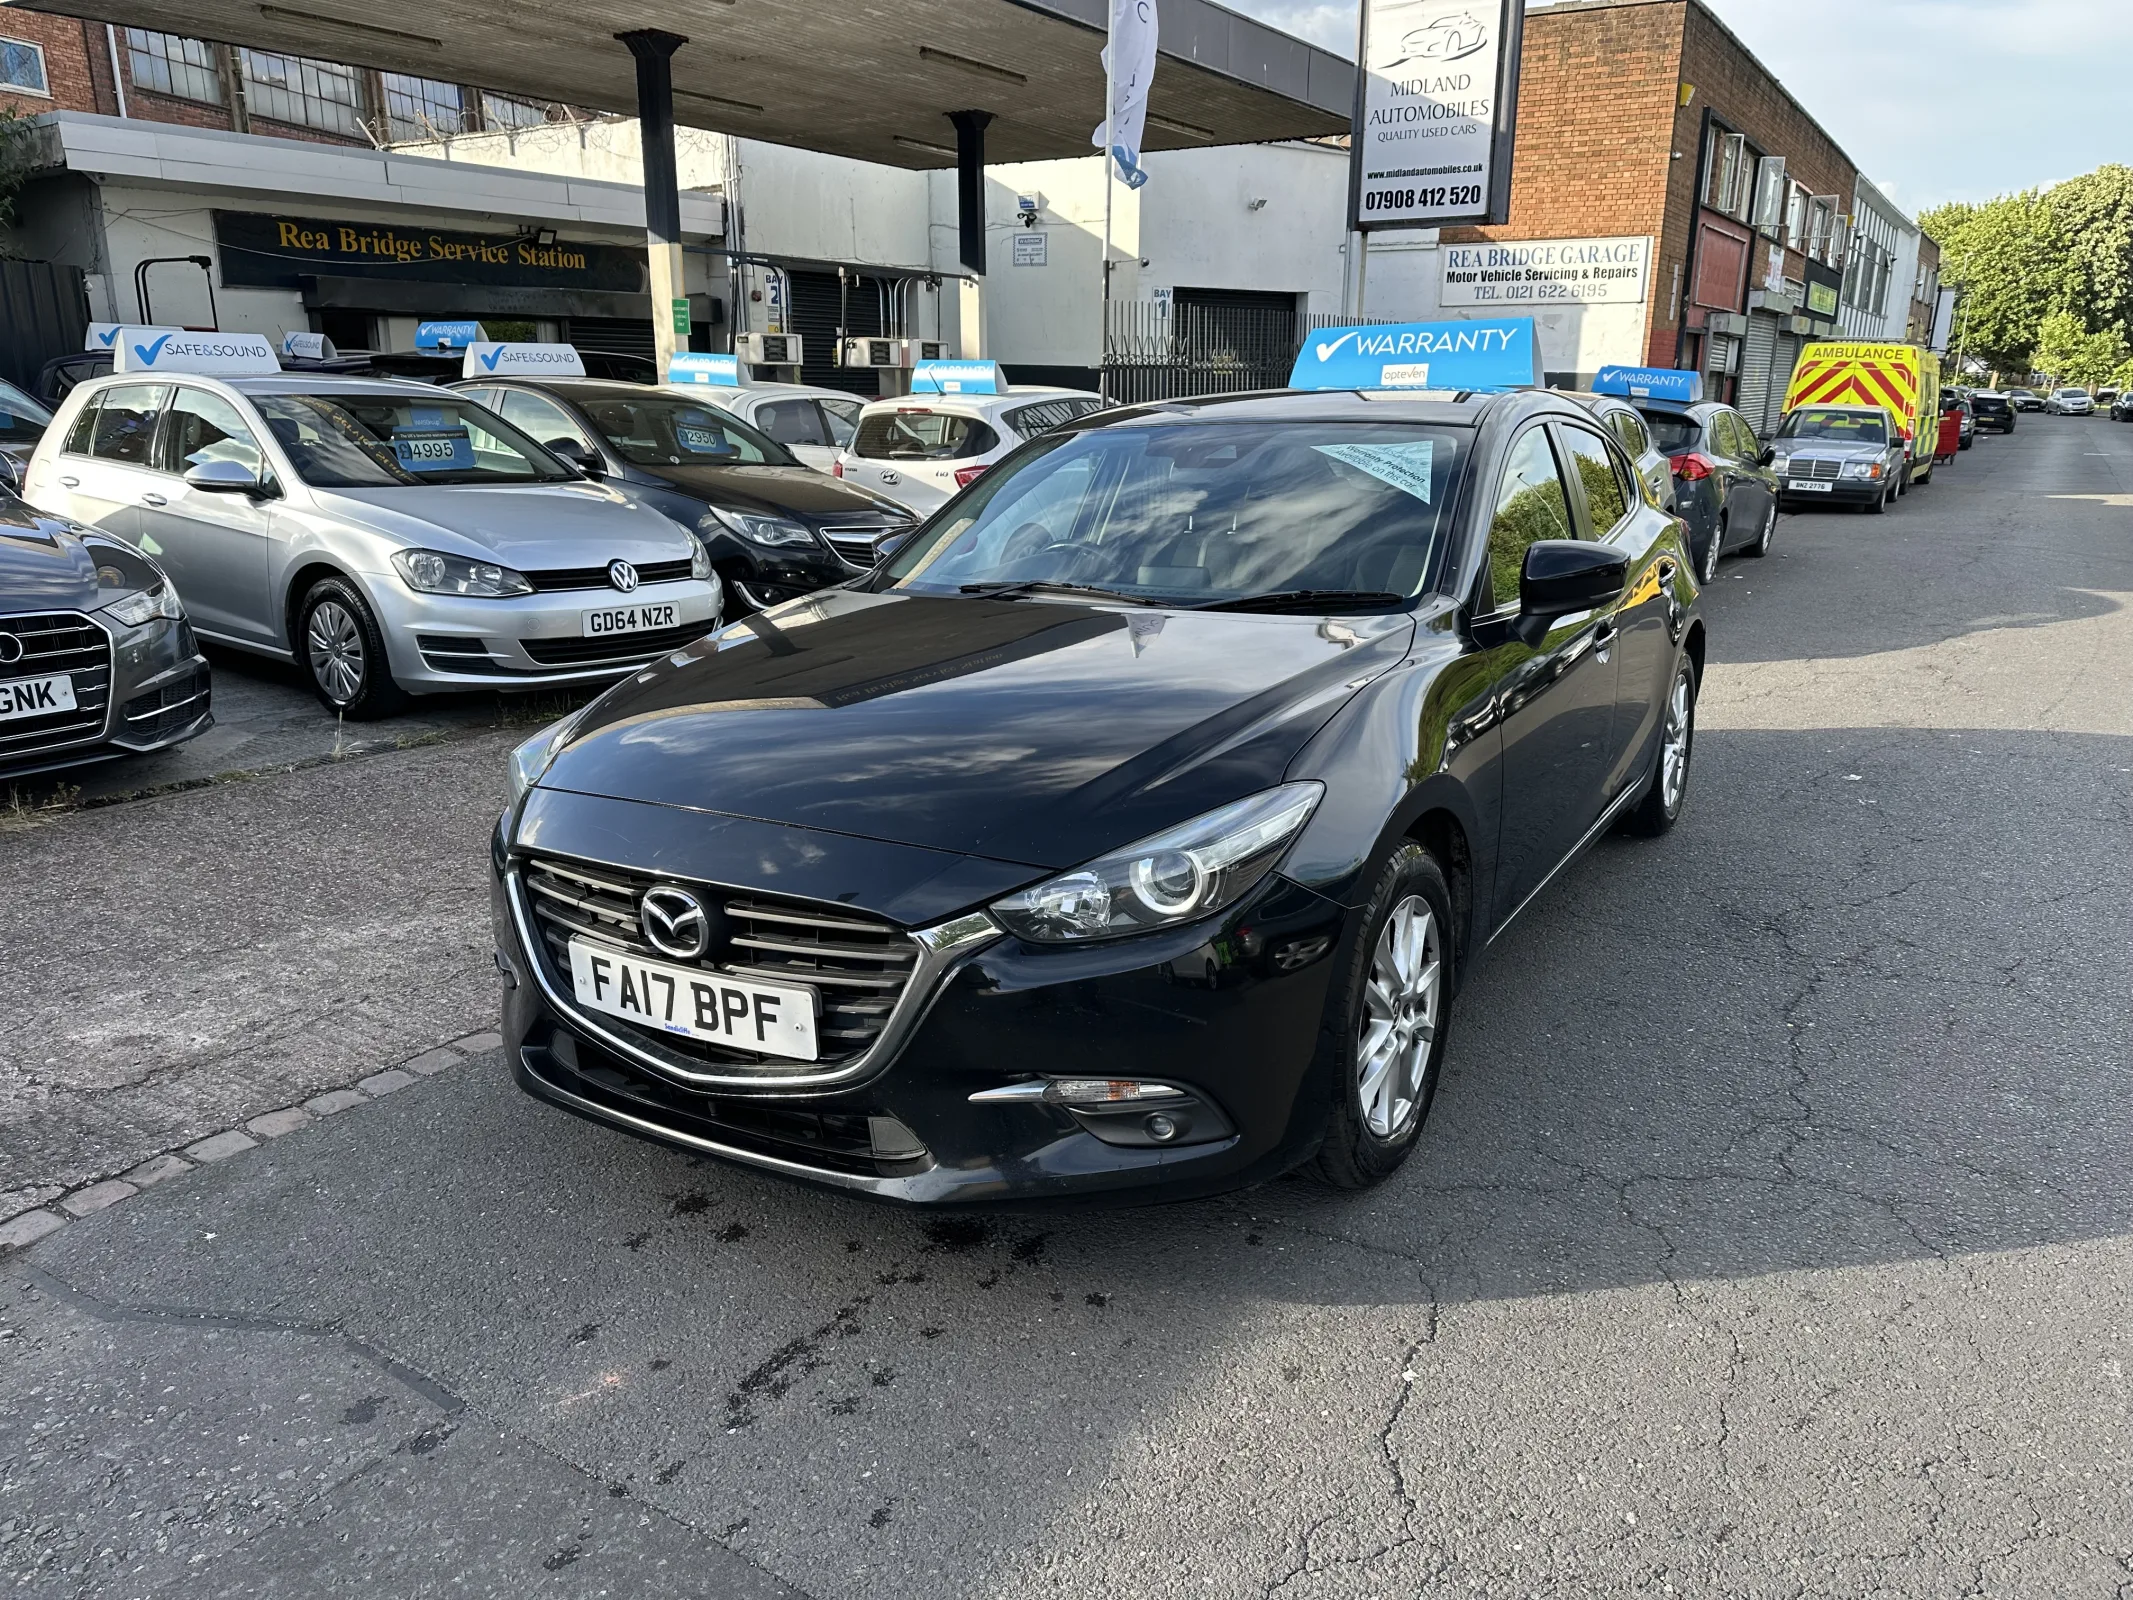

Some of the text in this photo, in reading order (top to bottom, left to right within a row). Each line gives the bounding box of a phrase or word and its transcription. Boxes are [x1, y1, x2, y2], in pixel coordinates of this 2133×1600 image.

[1390, 73, 1471, 97] MIDLAND
[1369, 99, 1490, 125] AUTOMOBILES
[1377, 124, 1477, 142] QUALITY USED CARS
[1367, 162, 1483, 179] www.midlandautomobiles.co.uk
[1365, 184, 1481, 210] 07908 412 520
[276, 222, 586, 269] Rea Bridge Service Station
[1448, 243, 1641, 268] REA BRIDGE GARAGE
[1446, 266, 1638, 283] Motor Vehicle Servicing & Repairs
[770, 286, 779, 304] 2
[1154, 289, 1171, 298] BAY
[1474, 283, 1607, 300] TEL. 0121 622 6195
[1158, 300, 1167, 317] 1
[431, 324, 474, 335] WARRANTY
[164, 343, 267, 358] SAFE&SOUND
[1356, 328, 1518, 356] WARRANTY
[501, 352, 575, 363] SAFE&SOUND
[1812, 348, 1904, 360] AMBULANCE
[1384, 365, 1426, 382] opteven
[1620, 371, 1686, 387] WARRANTY
[1346, 444, 1426, 483] Warranty Protection
[1372, 465, 1384, 474] on
[1384, 470, 1401, 482] this
[1400, 479, 1416, 489] car
[1808, 482, 1826, 490] 2776
[590, 605, 674, 633] GD64 NZR
[0, 680, 57, 715] GNK
[590, 955, 781, 1042] FA17 BPF
